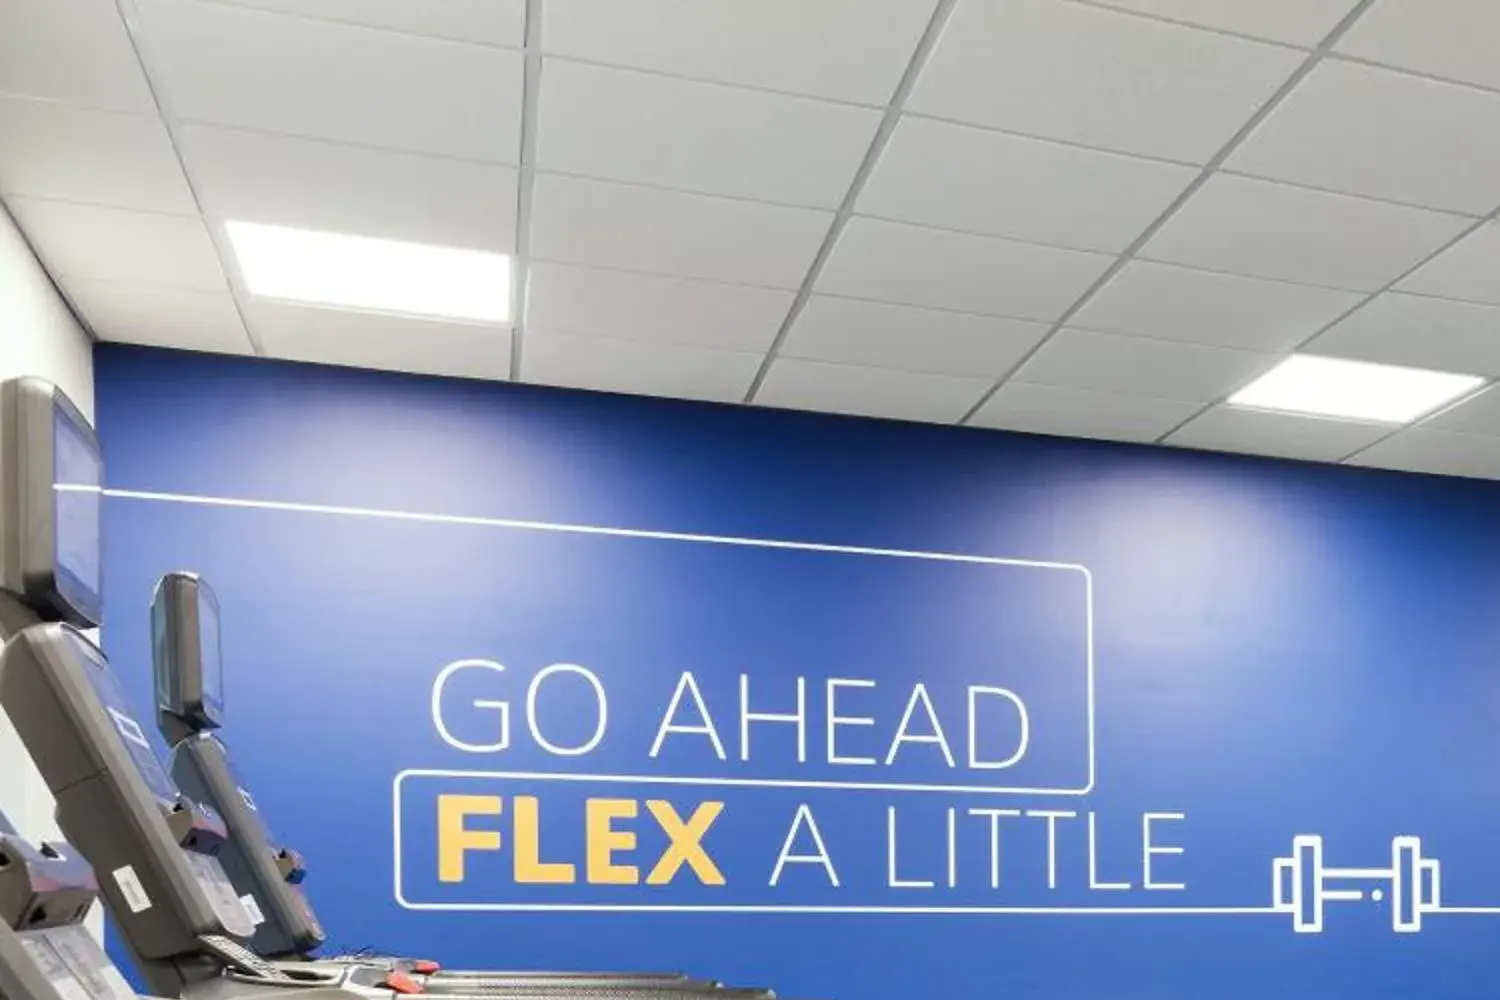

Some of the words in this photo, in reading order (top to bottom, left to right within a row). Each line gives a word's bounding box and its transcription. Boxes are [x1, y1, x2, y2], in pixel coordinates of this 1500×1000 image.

[430, 658, 608, 757] GO
[648, 670, 1029, 769] AHEAD
[437, 793, 726, 885] FLEX
[768, 803, 840, 886] A
[888, 805, 1186, 889] LITTLE
